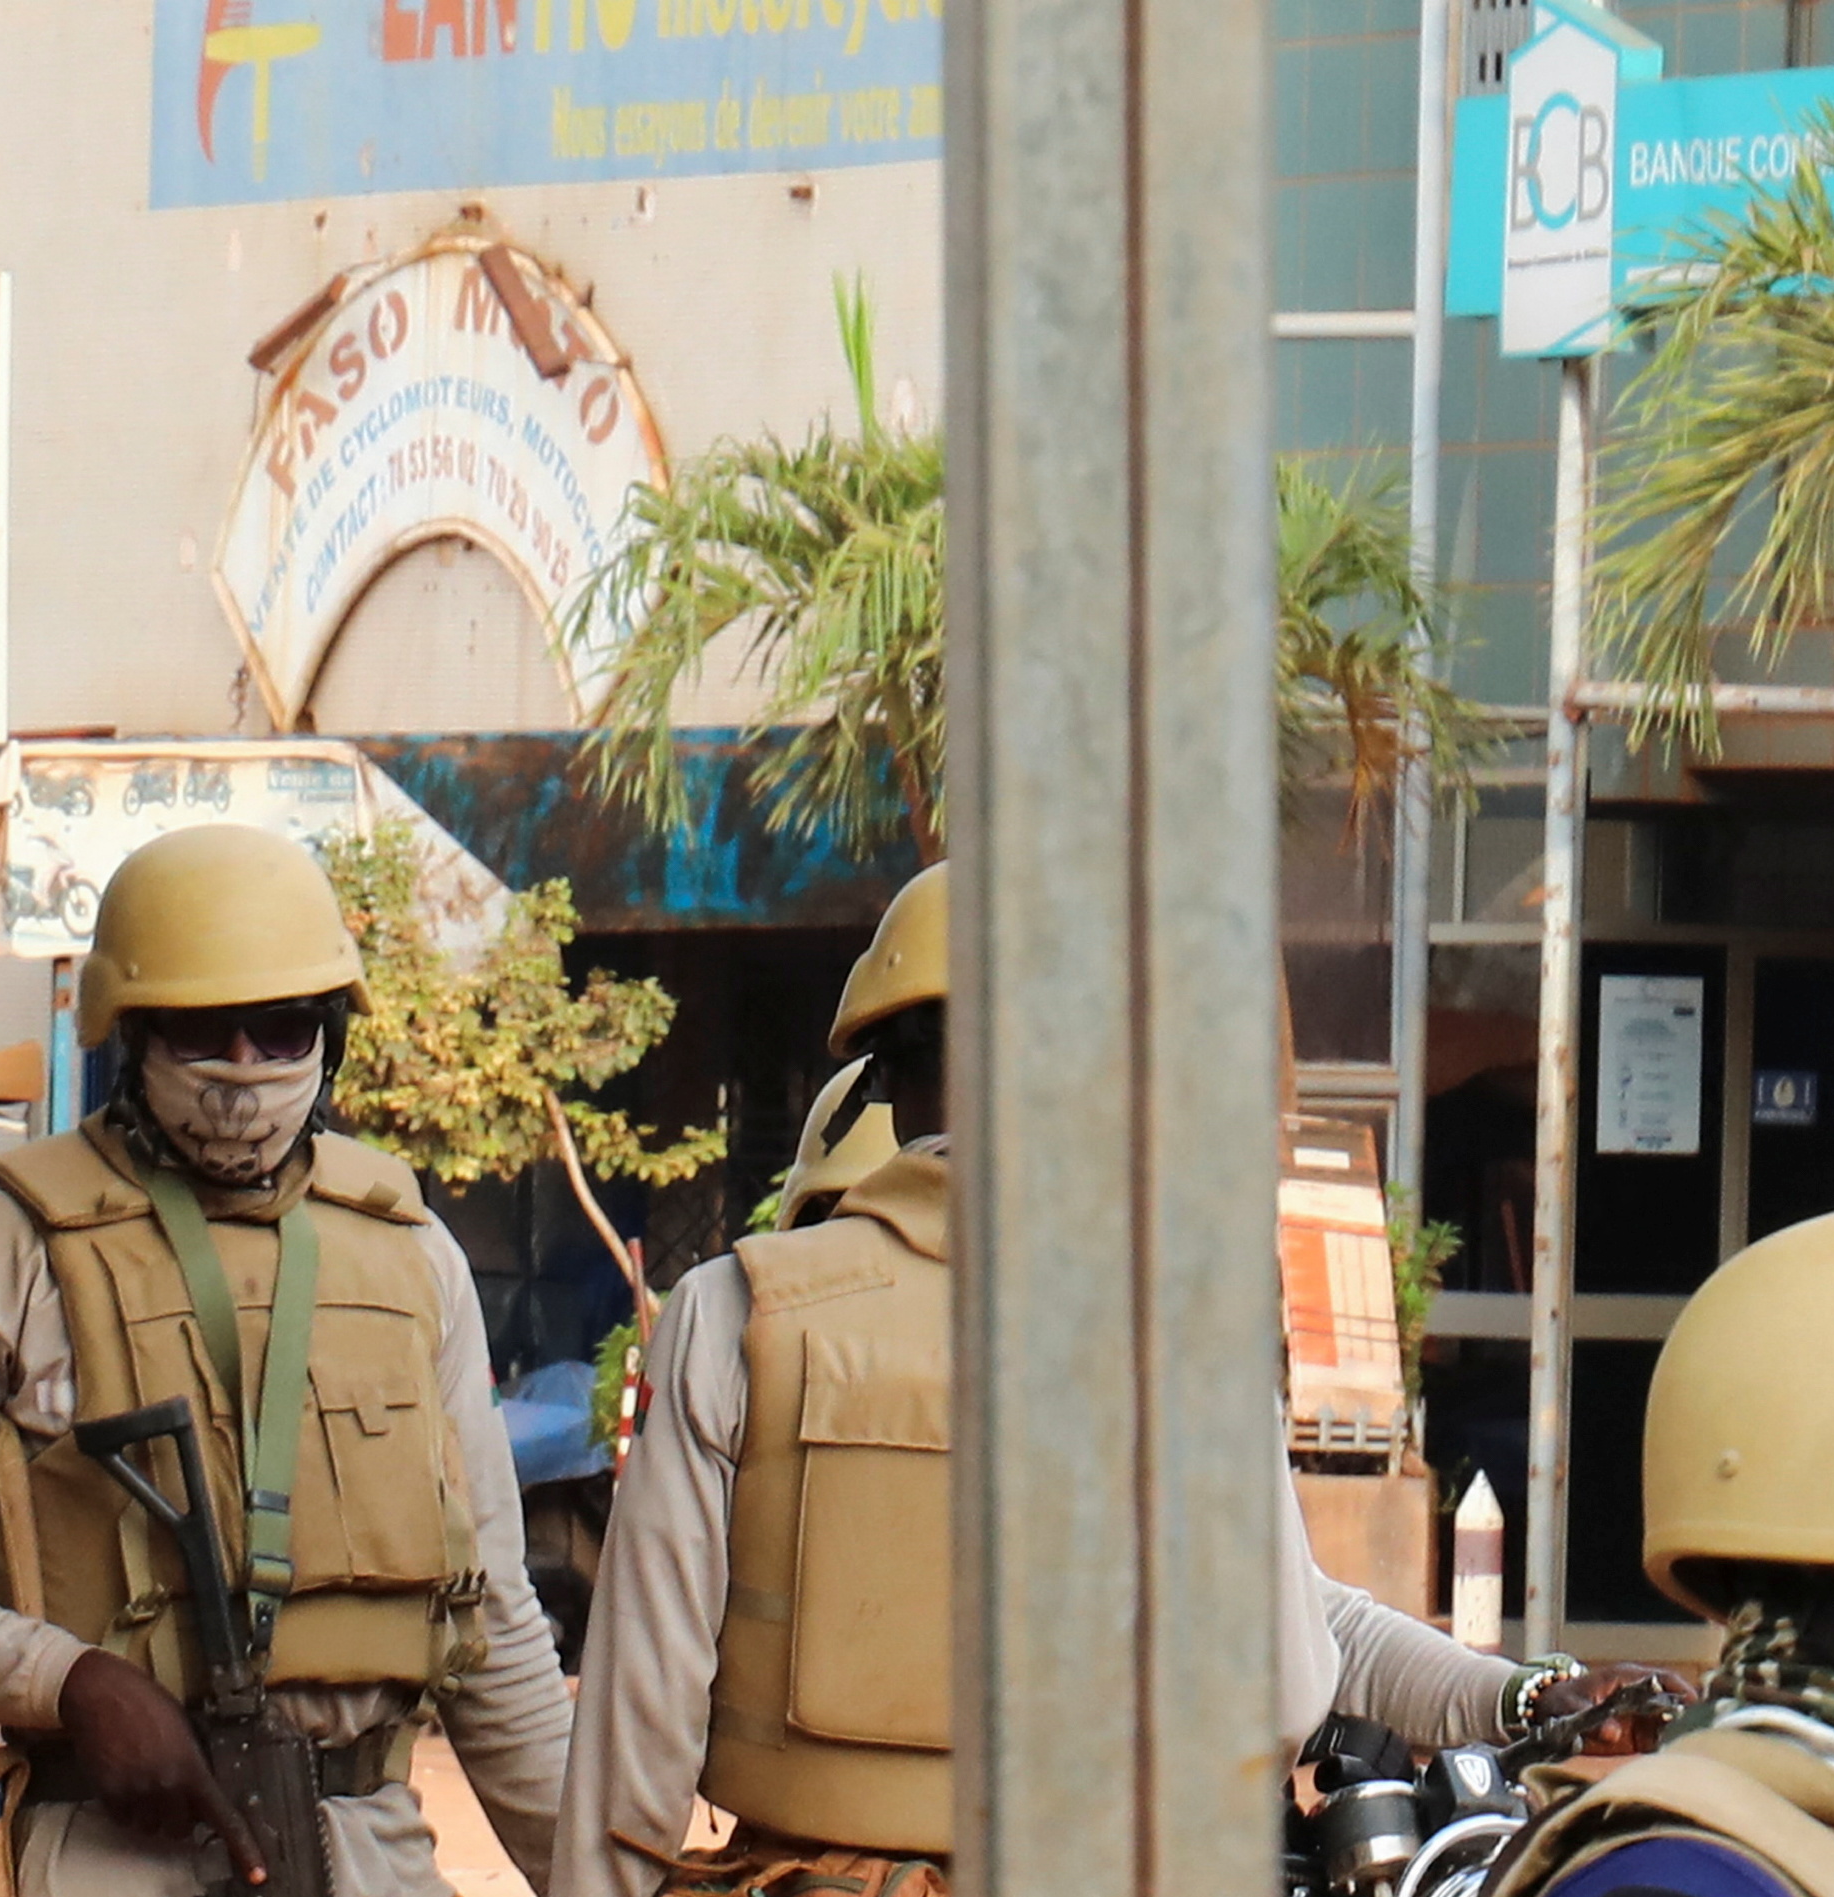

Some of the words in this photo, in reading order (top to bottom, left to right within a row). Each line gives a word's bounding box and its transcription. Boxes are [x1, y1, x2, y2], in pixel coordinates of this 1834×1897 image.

[716, 75, 741, 150] de
[1511, 91, 1608, 231] BCB
[1629, 137, 1743, 188] BANQUE
[266, 290, 409, 500] FASO
[454, 268, 620, 445] MO
[250, 503, 308, 633] VENTE
[307, 459, 335, 509] DE
